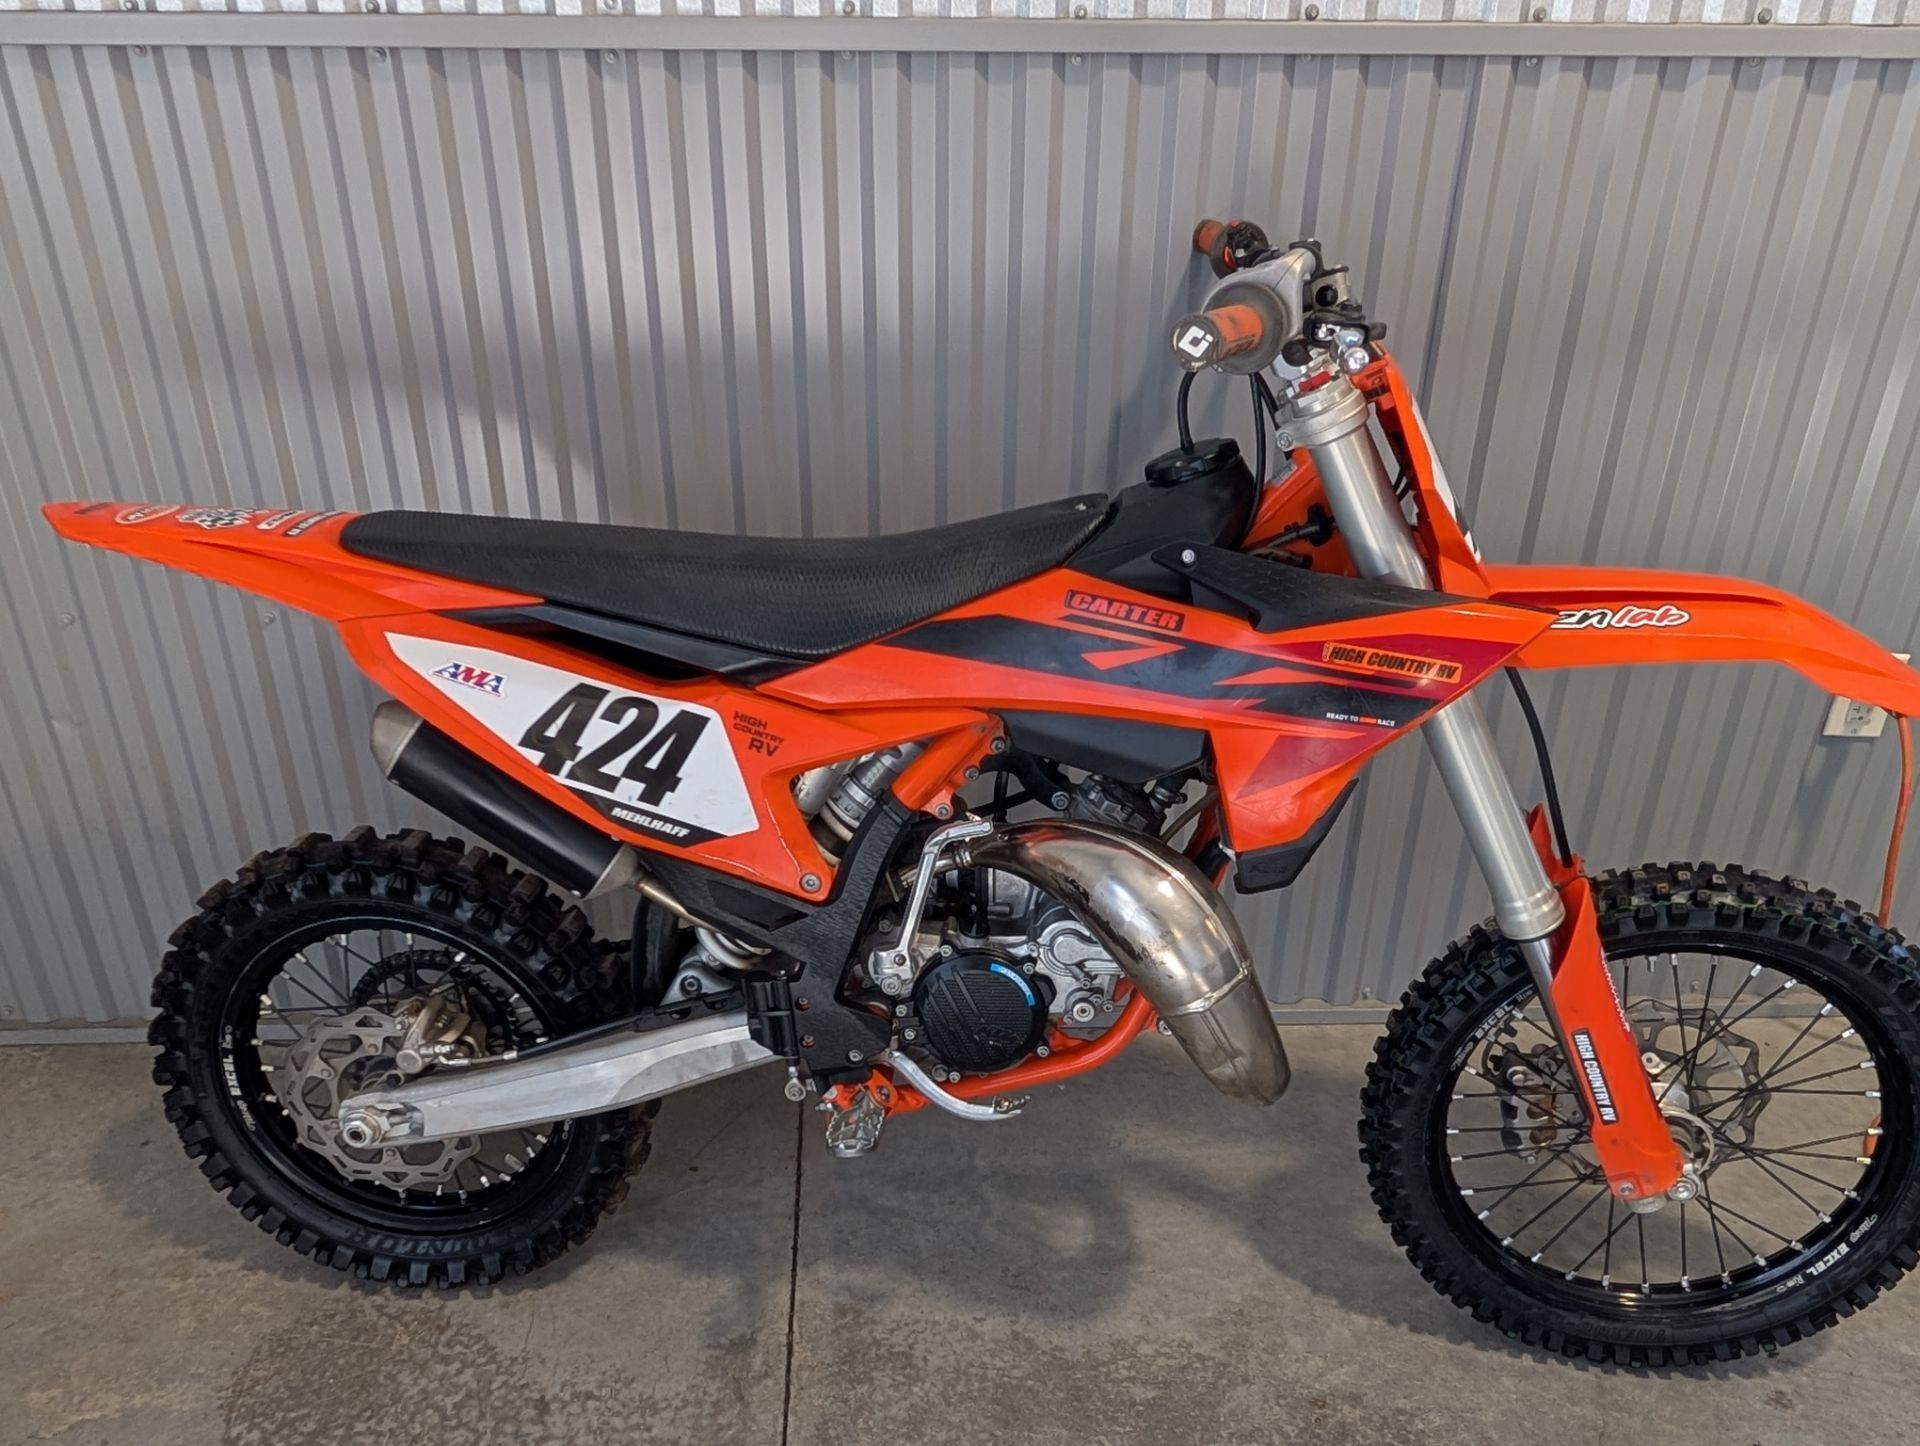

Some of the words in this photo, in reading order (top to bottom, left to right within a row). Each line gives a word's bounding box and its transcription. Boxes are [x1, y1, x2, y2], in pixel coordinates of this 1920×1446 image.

[1070, 593, 1180, 630] CARTER
[432, 661, 505, 696] AMA
[1330, 645, 1367, 666] HIGH
[1367, 652, 1437, 676] COUNTRY
[1435, 664, 1460, 680] RV
[733, 711, 768, 731] HIGH
[733, 723, 784, 745] COUNTRY
[1326, 712, 1348, 722] READY
[1349, 714, 1359, 722] TO
[1377, 718, 1396, 727] RACE
[517, 682, 711, 808] 424
[748, 737, 780, 757] RV
[611, 806, 691, 838] MEHLHAFF
[1475, 1004, 1514, 1039] EXCEL
[1574, 1034, 1596, 1062] HIGH
[223, 1055, 242, 1096] EXCEL
[1584, 1060, 1612, 1109] COUNTRY
[1600, 1106, 1617, 1122] RV
[1805, 1241, 1851, 1276] EXCEL
